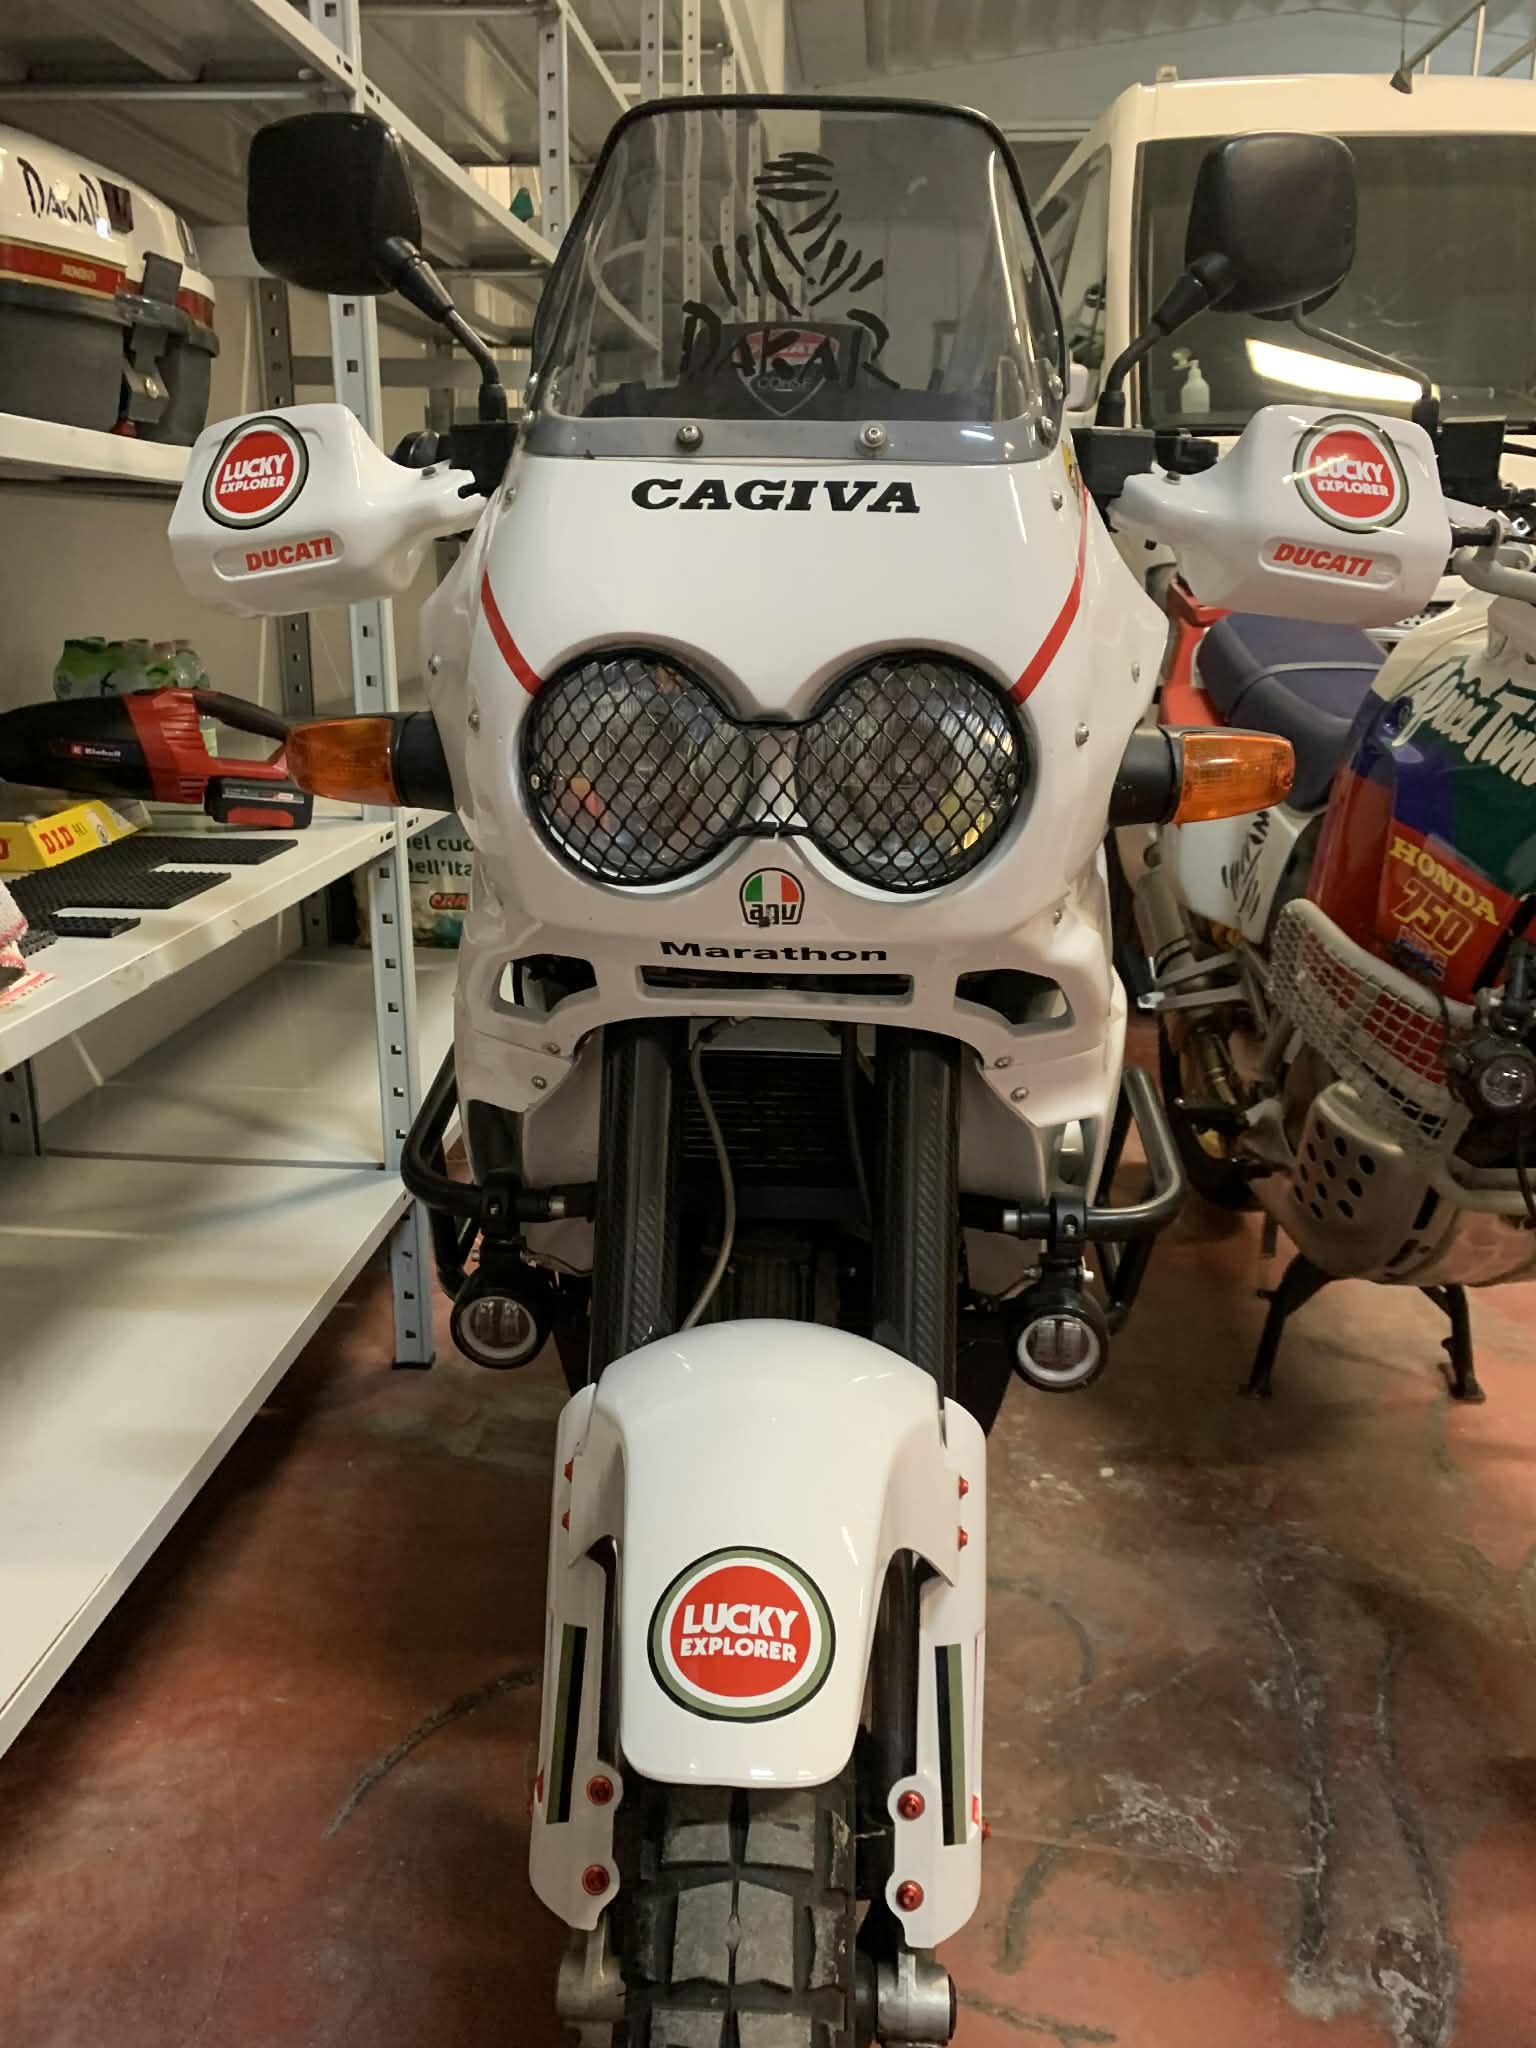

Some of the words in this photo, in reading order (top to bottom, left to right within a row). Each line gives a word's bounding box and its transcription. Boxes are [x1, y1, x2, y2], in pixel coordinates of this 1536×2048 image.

[682, 300, 901, 390] DAKAR
[223, 452, 287, 482] LUCKY
[1315, 455, 1384, 483] LUCKY
[219, 474, 286, 494] EXPLORER
[631, 478, 920, 513] CAGIVA
[1317, 479, 1389, 497] EXPLORER
[245, 536, 333, 572] DUCATI
[1273, 543, 1373, 577] DUCATI
[39, 826, 75, 855] DID
[1390, 836, 1499, 926] HONDA
[749, 903, 798, 925] agv
[1391, 877, 1475, 956] 750
[660, 941, 888, 961] Marathon
[682, 1603, 799, 1640] LUCKY
[680, 1637, 797, 1664] EXPLORER
